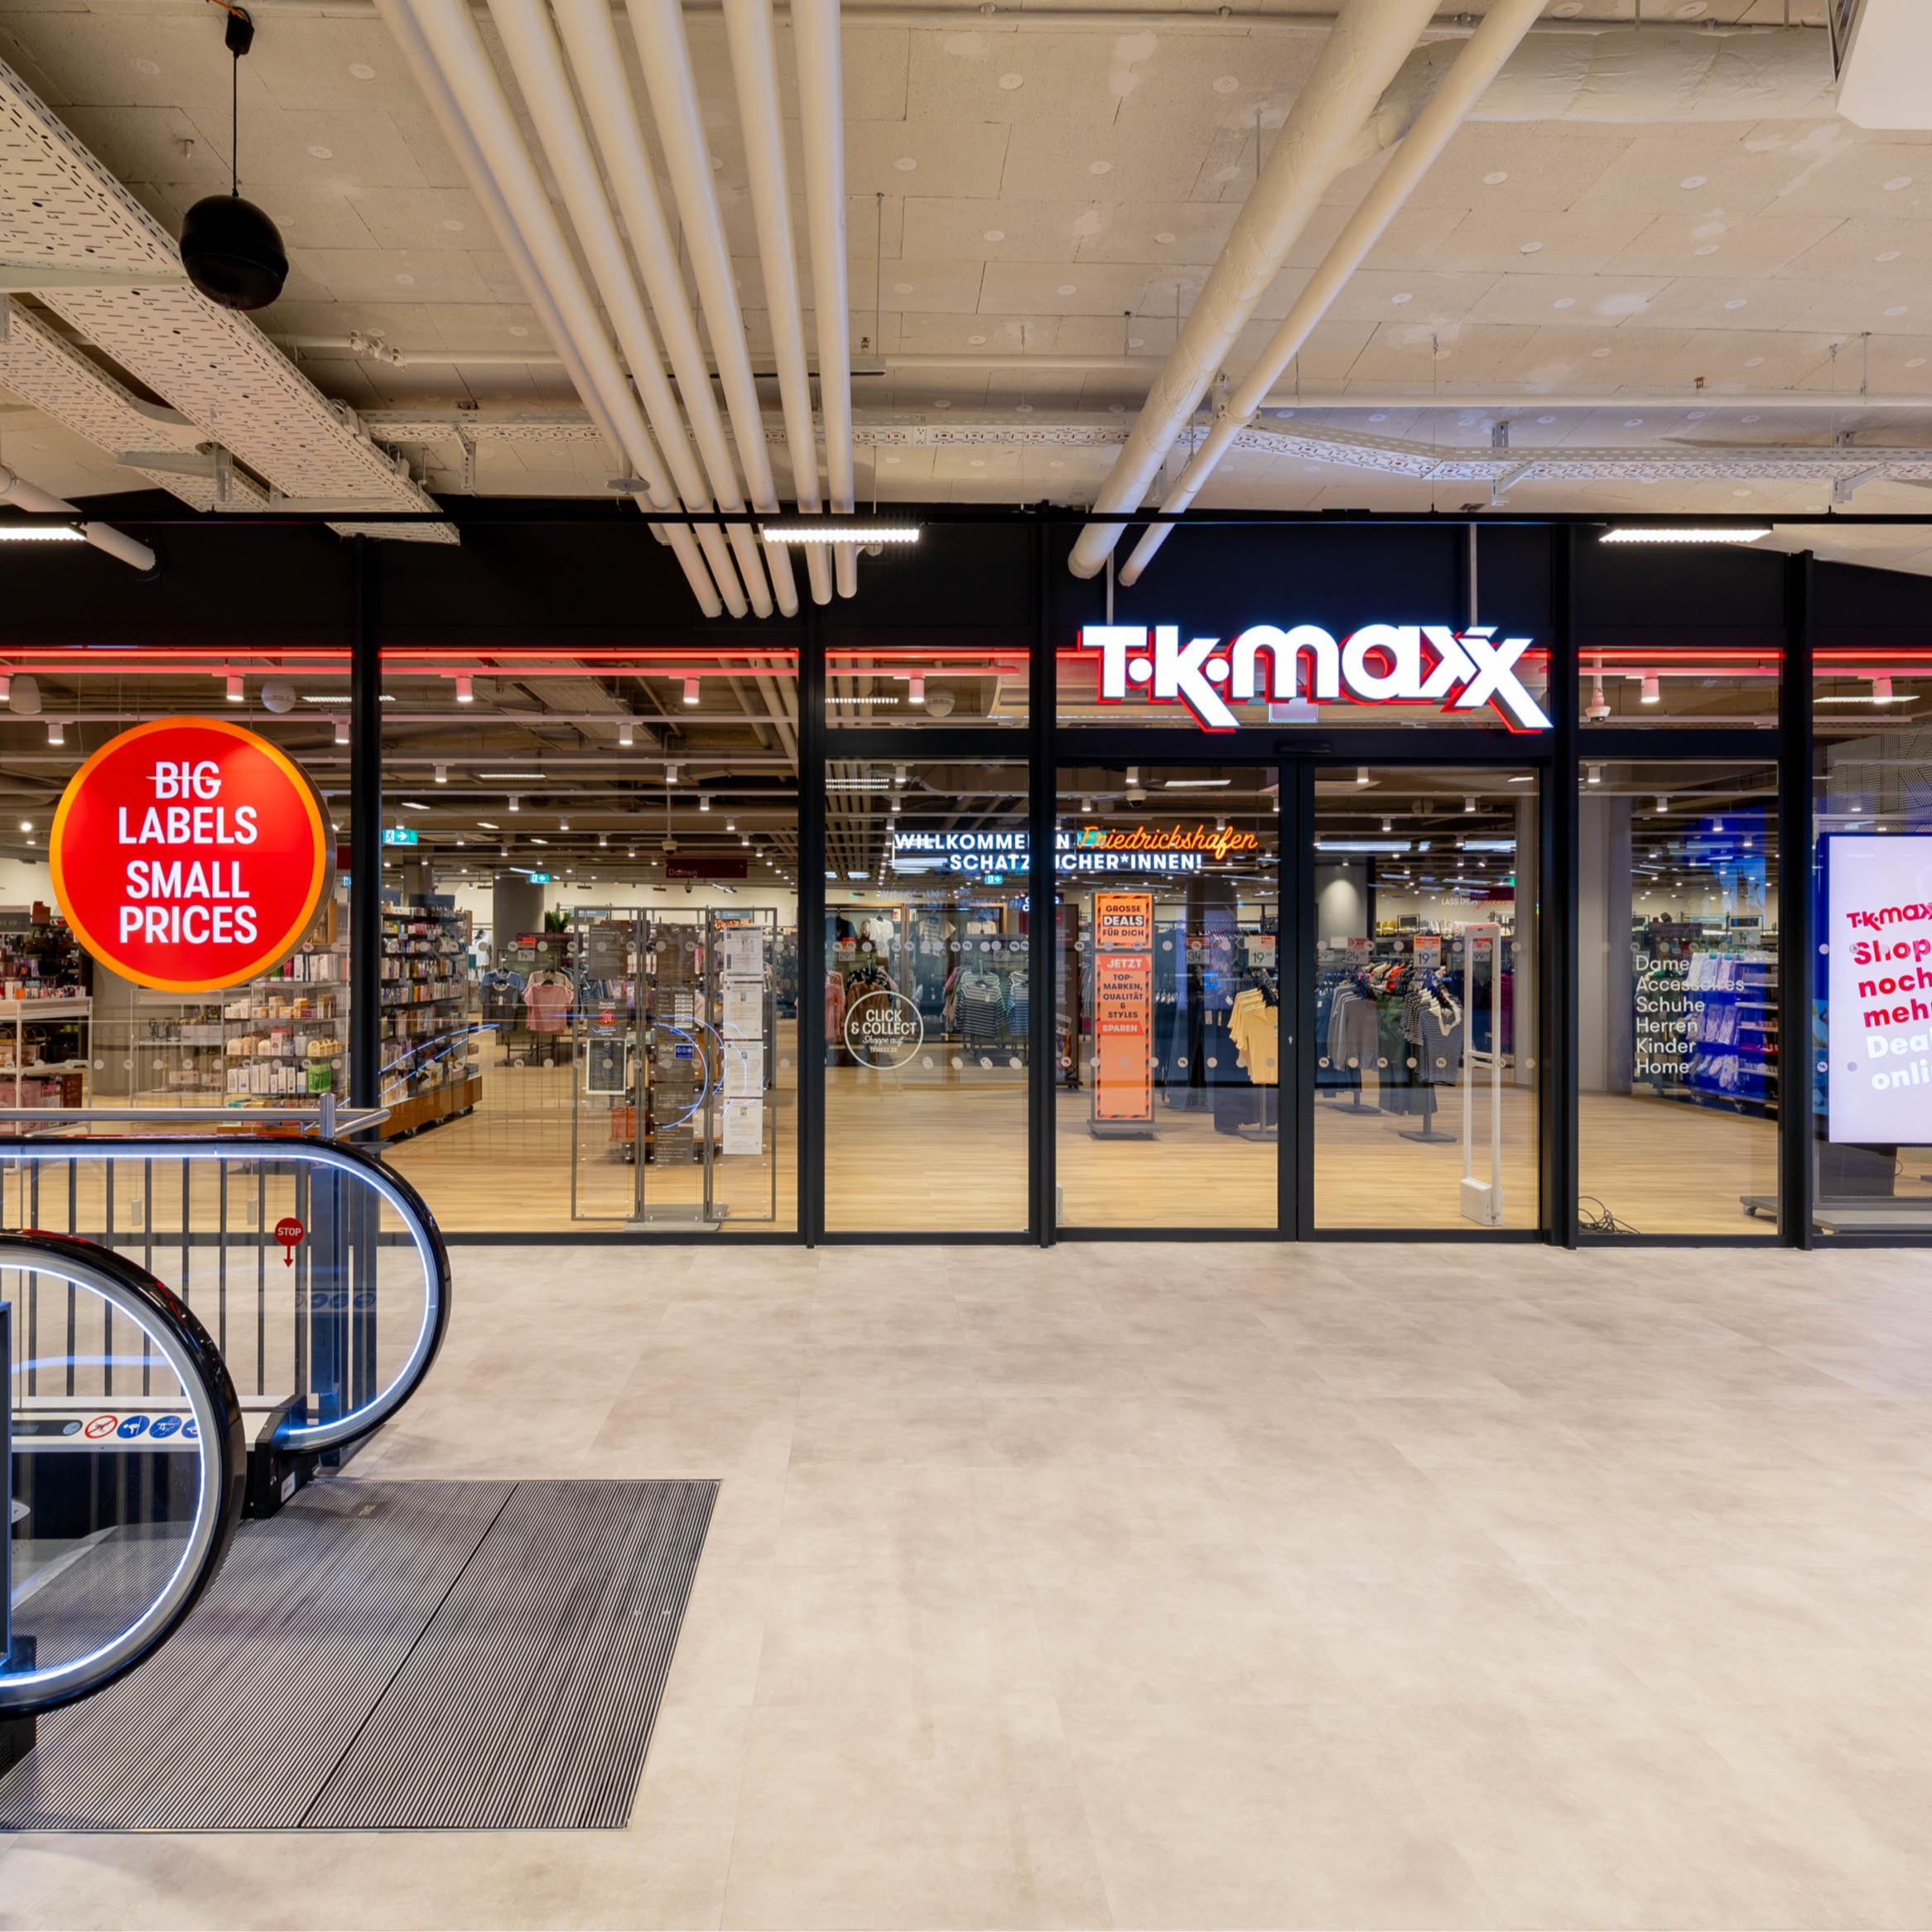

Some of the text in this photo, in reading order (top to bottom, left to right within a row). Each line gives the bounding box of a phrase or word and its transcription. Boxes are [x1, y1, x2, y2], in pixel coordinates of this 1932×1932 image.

[155, 762, 221, 798] BIG
[118, 807, 258, 844] LABELS
[895, 834, 1033, 850] WILLKOMME
[1077, 826, 1258, 860] Friedrichshafen
[126, 860, 249, 899] SMALL
[120, 906, 258, 943] PRICES
[1104, 917, 1143, 926] DEALS
[1103, 927, 1120, 937] FÜR
[1106, 959, 1143, 968] JETZT
[1188, 952, 1201, 961] 34
[1858, 967, 1932, 998] noch
[1103, 991, 1143, 1000] QUALITÄT
[1636, 996, 1705, 1012] Schuhe
[865, 1009, 902, 1022] CLICK
[1863, 998, 1932, 1028] meh
[850, 1022, 917, 1035] & COLLECT
[1636, 1017, 1698, 1033] Herren
[889, 1036, 903, 1048] auf
[1636, 1038, 1696, 1053] Kinder
[1636, 1058, 1689, 1074] Home
[1871, 1058, 1932, 1091] onli
[277, 1226, 301, 1236] STOP
